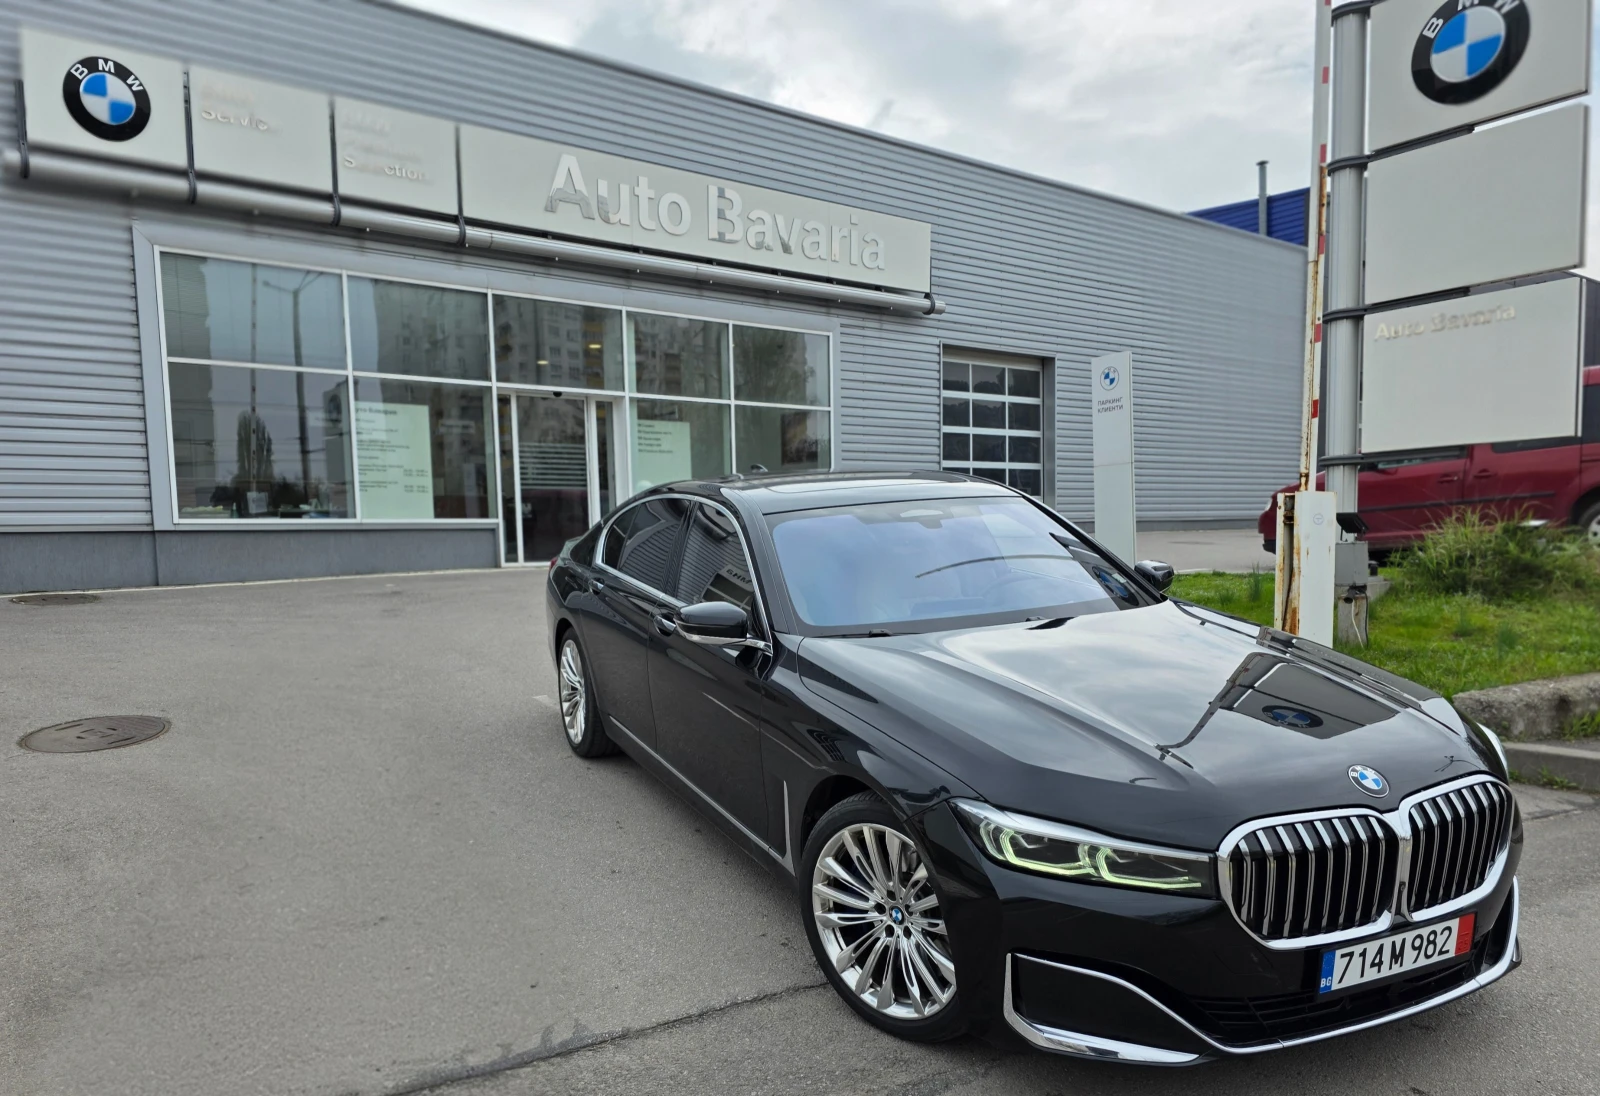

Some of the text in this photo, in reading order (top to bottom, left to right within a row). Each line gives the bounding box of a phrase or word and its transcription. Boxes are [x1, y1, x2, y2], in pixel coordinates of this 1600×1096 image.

[70, 58, 144, 92] BMW
[544, 153, 886, 271] Auto Bavaria
[1097, 397, 1123, 406] ПАРКИНГ
[1097, 404, 1124, 414] КЛИЕНТИ
[1320, 976, 1332, 988] BG
[1338, 925, 1453, 984] 714M982
